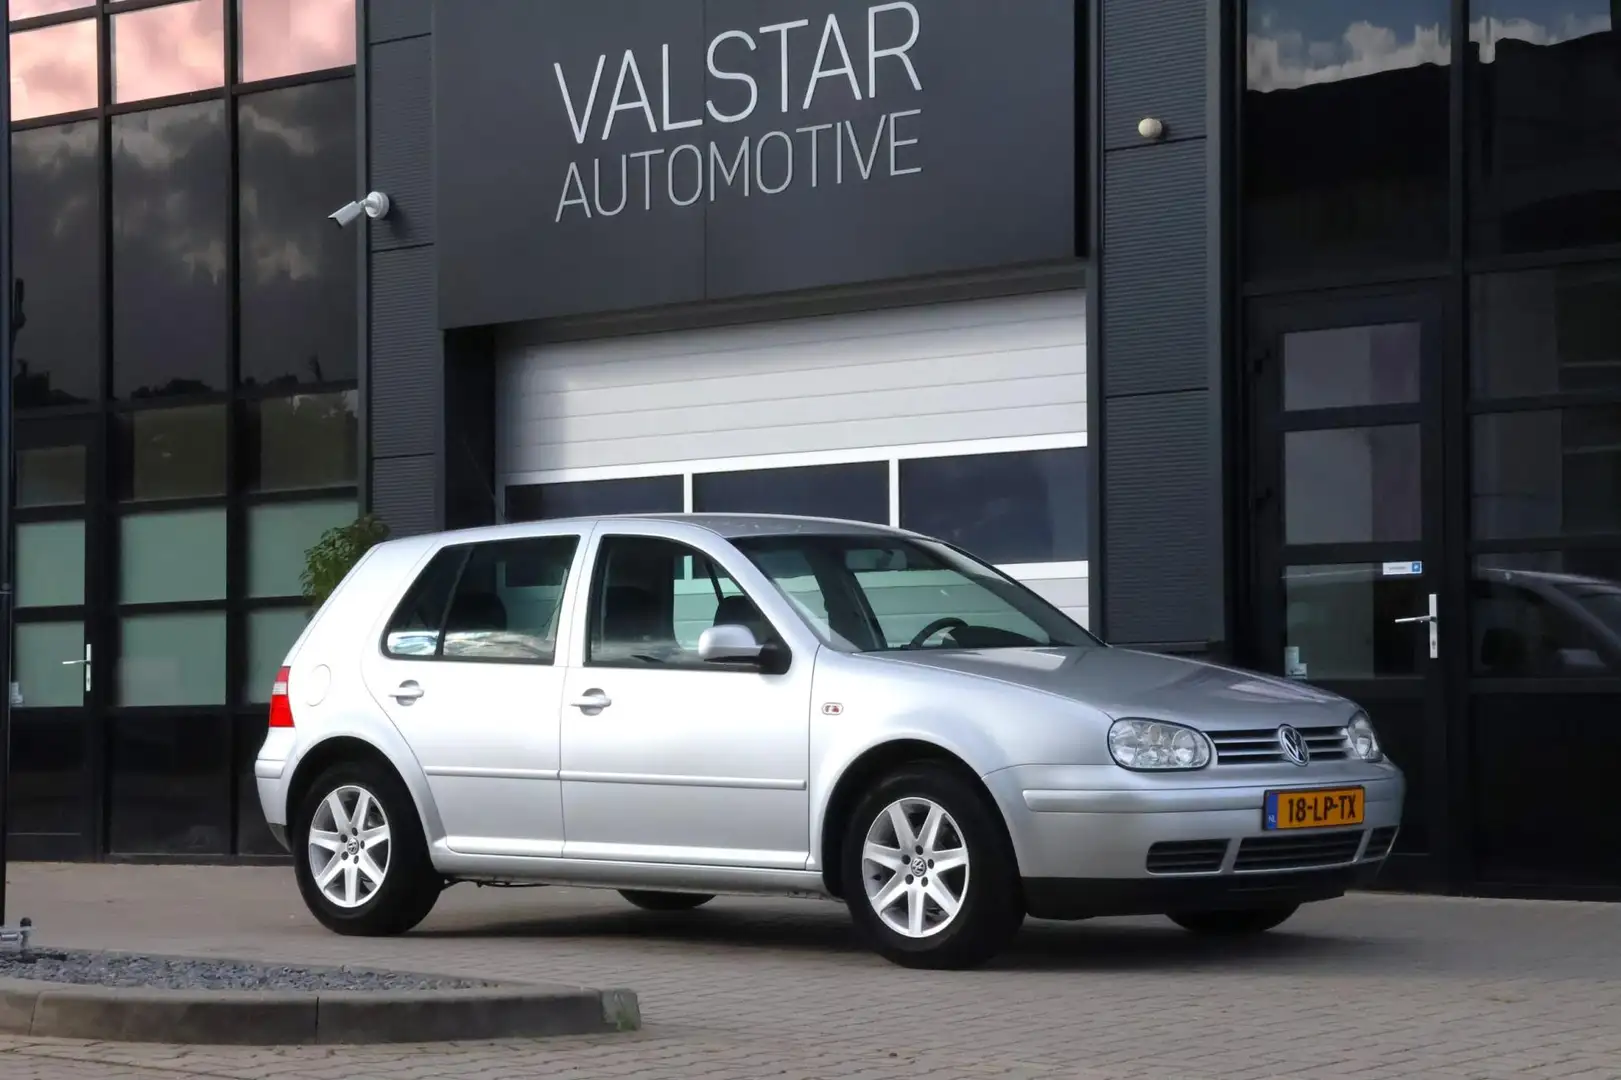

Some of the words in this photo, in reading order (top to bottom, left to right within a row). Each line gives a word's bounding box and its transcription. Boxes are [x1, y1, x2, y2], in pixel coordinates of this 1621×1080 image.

[553, 1, 922, 144] VALSTAR
[555, 109, 922, 222] AUTOMOTIVE
[1288, 793, 1357, 824] 18-LP-TX
